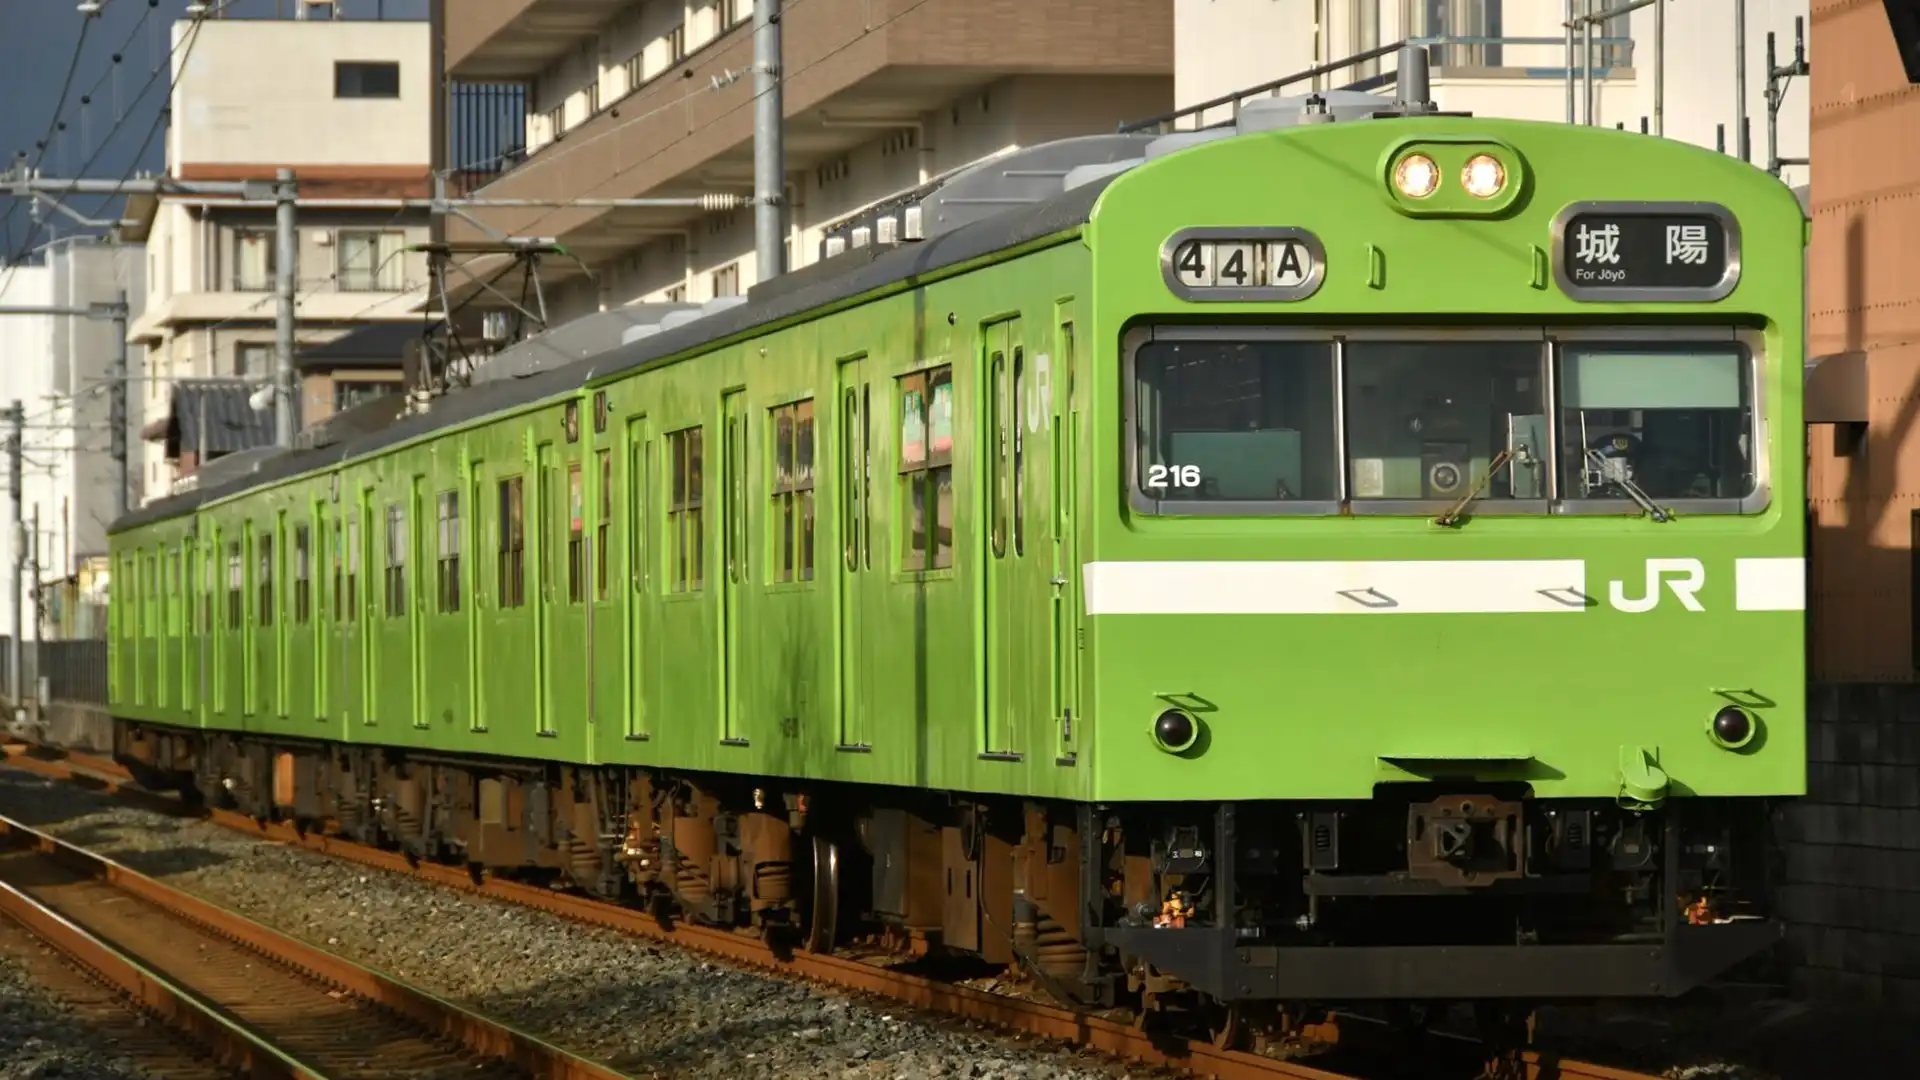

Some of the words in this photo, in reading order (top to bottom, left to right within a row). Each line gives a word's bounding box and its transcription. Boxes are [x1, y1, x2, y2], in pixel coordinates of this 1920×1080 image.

[1575, 223, 1709, 265] 城陽
[1575, 268, 1596, 280] For
[1026, 353, 1050, 433] JR
[1148, 464, 1201, 487] 216
[1609, 557, 1706, 613] JR
